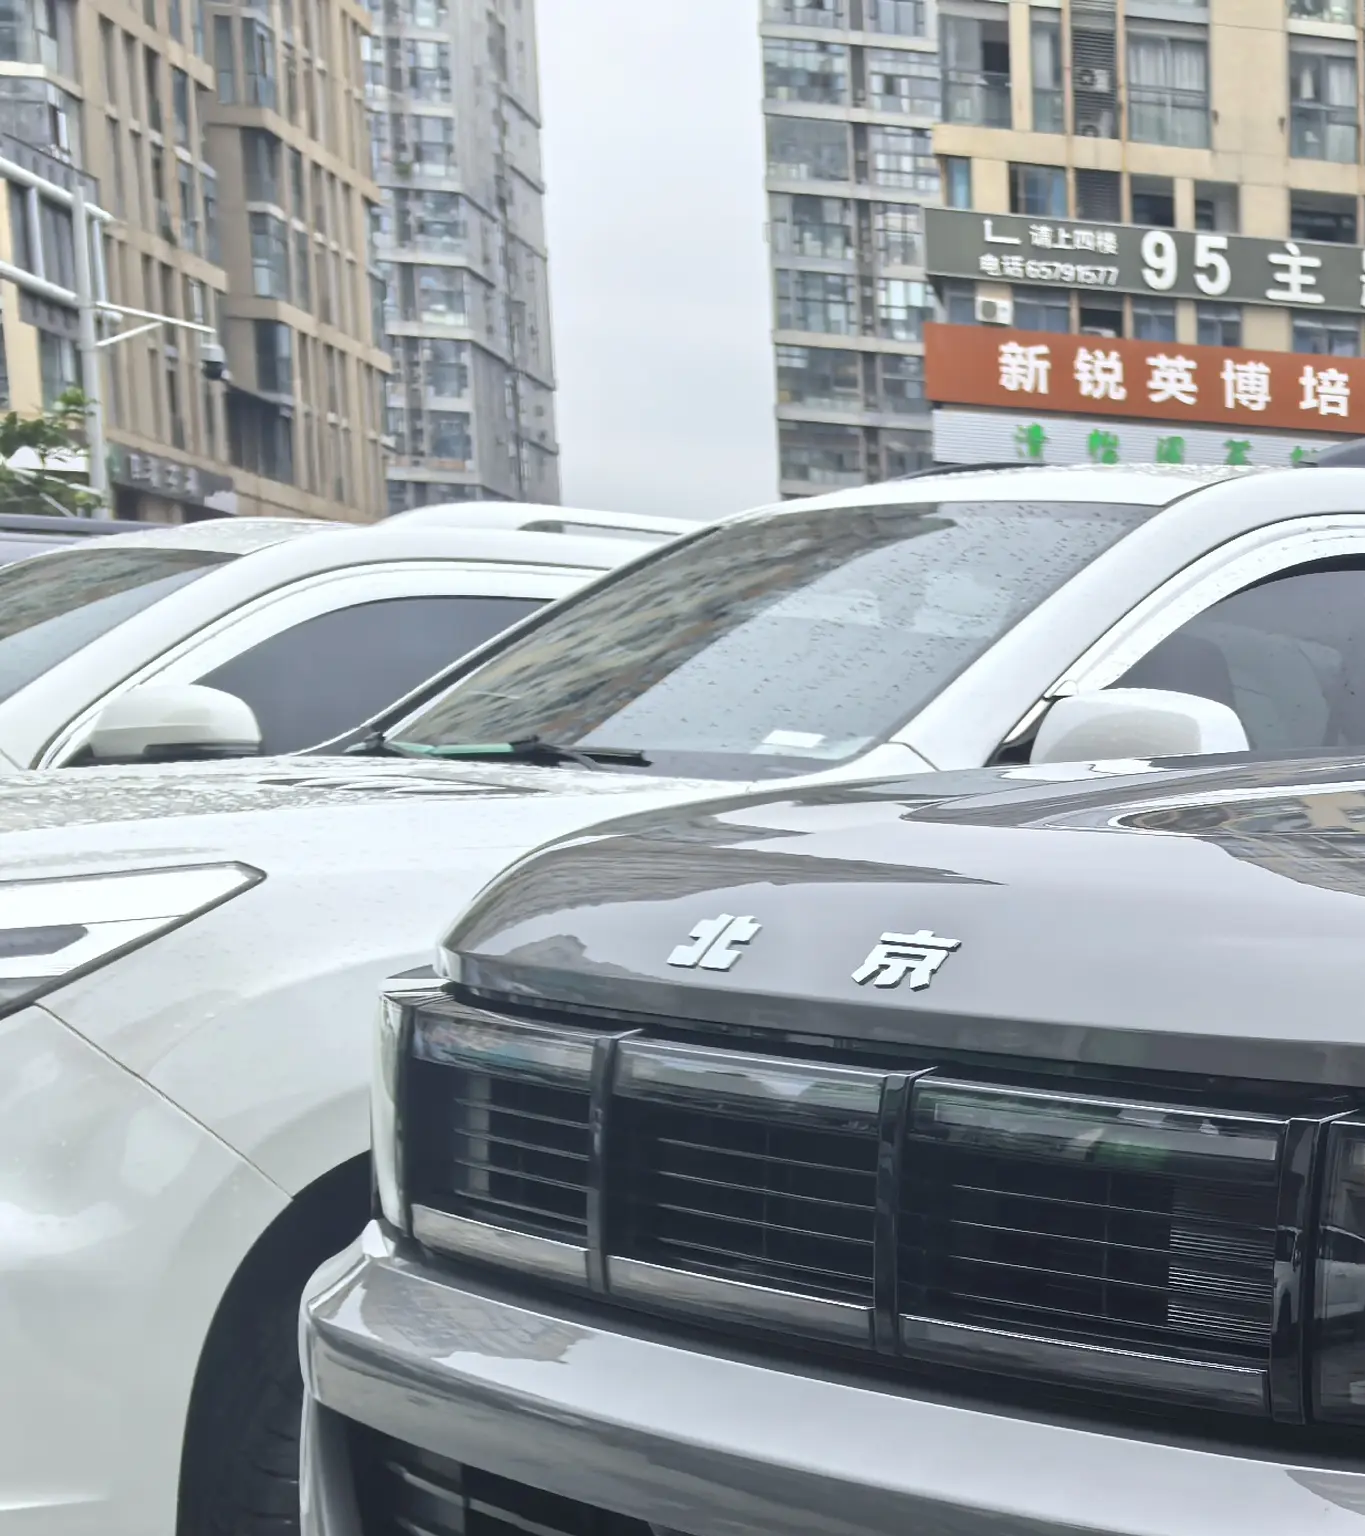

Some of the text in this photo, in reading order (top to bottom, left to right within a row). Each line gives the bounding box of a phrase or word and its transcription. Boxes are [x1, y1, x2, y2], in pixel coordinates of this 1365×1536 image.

[1029, 223, 1119, 256] 请上四楼
[667, 913, 962, 992] 北京
